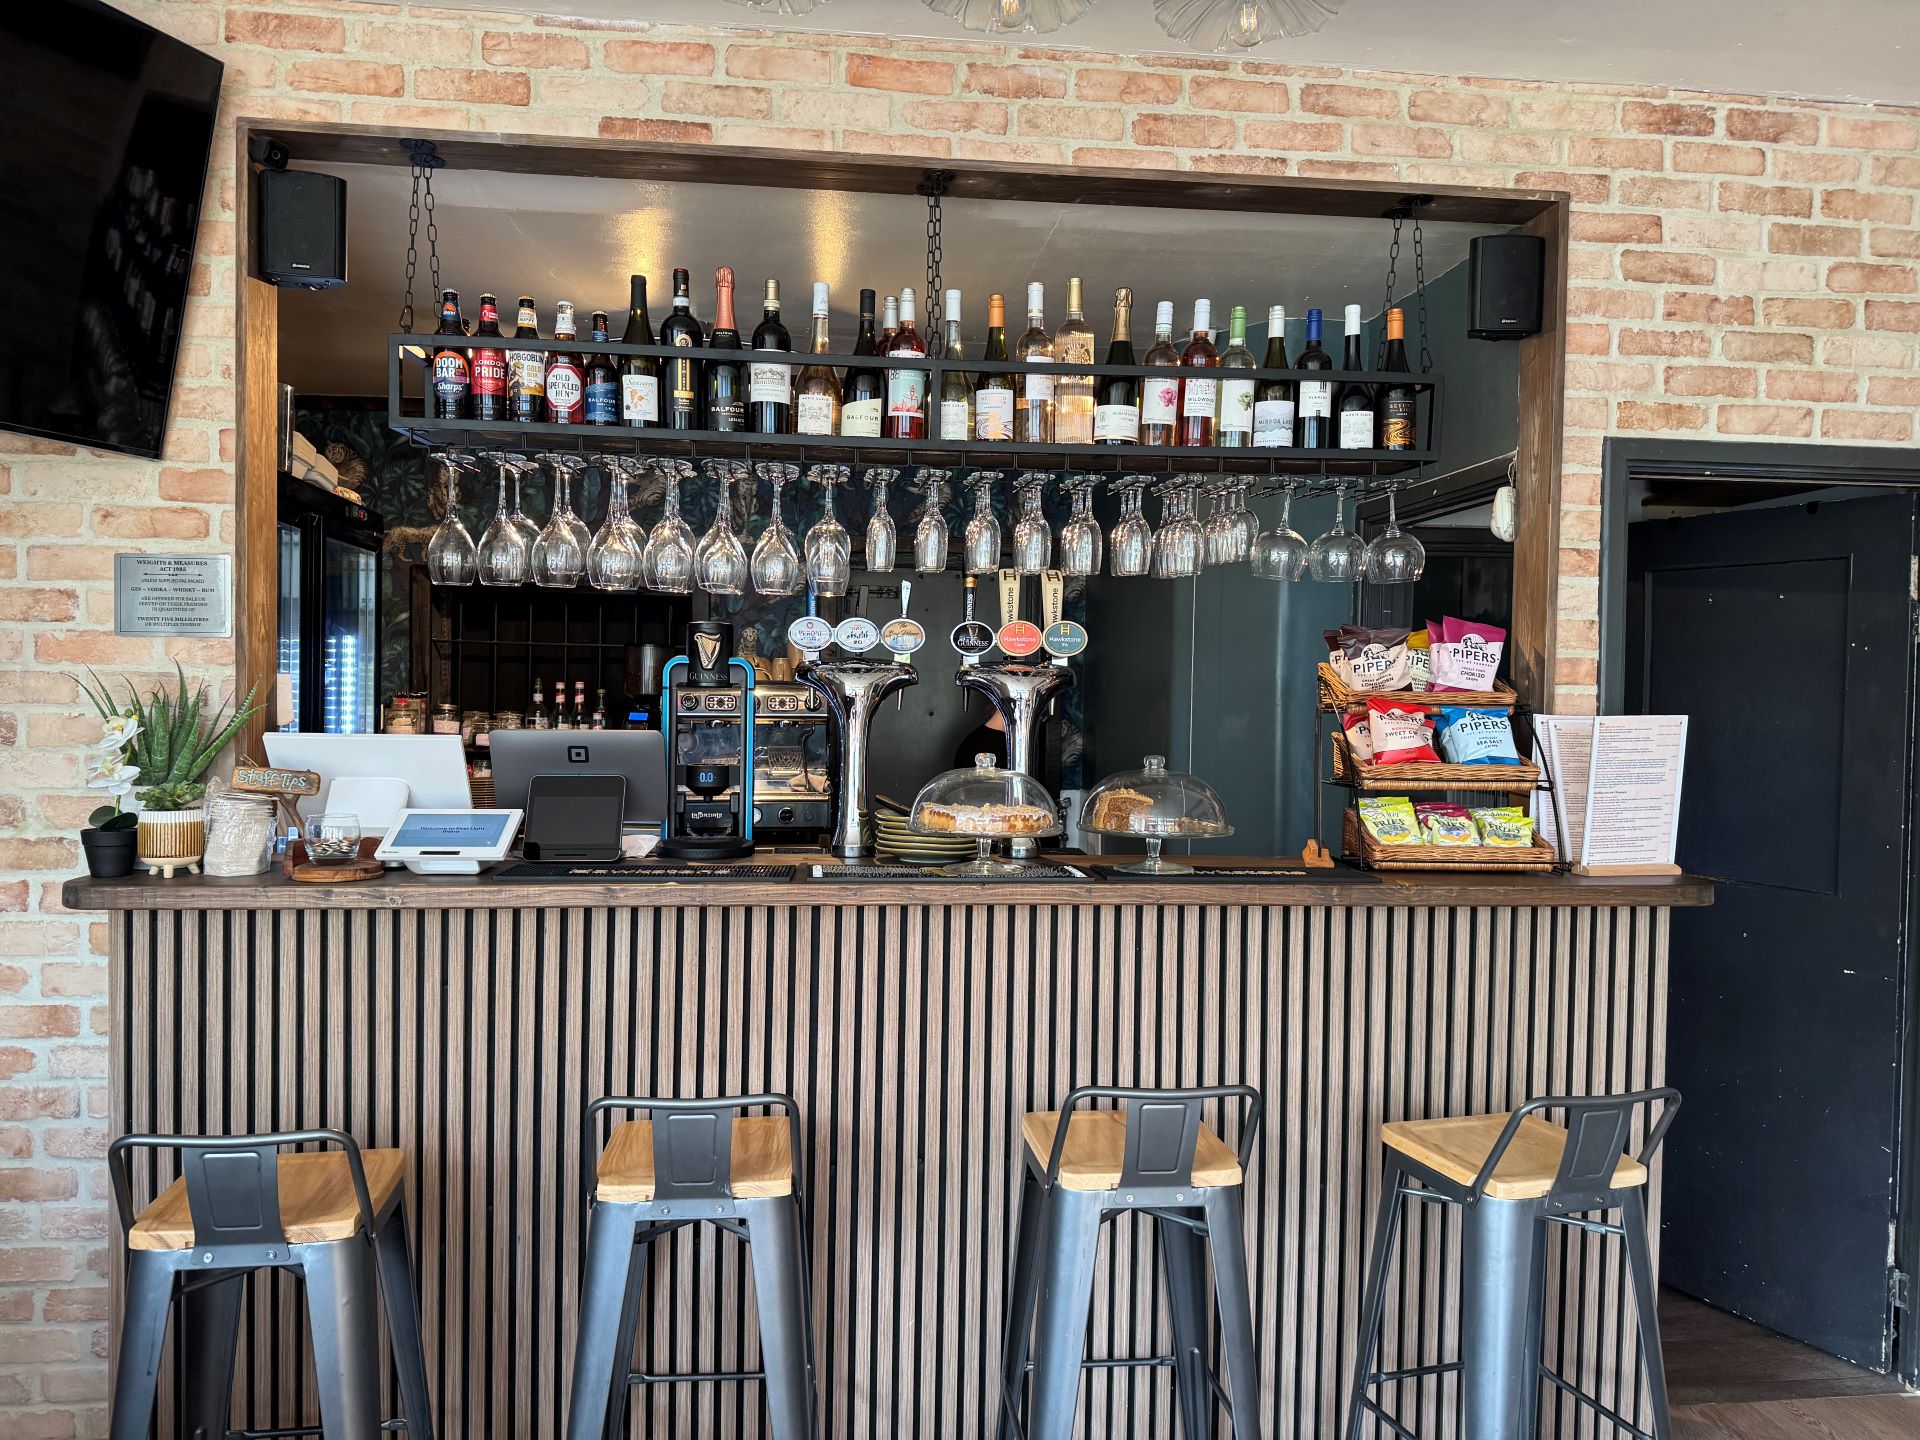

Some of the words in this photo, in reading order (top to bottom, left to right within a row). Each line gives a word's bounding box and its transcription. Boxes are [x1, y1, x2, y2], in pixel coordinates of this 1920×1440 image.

[436, 358, 463, 368] DOOM
[510, 352, 544, 364] HOBGOBLIN
[437, 368, 456, 378] BAR
[475, 367, 505, 379] PRIDE
[548, 382, 579, 391] SPECKLED
[1453, 648, 1496, 663] PIPERS
[690, 672, 728, 680] GUINNESS
[1361, 677, 1394, 687] LONGHORN
[1460, 721, 1508, 732] PIPERS
[237, 768, 280, 787] Staff
[280, 773, 307, 791] Tips
[700, 772, 713, 783] 0.0
[1373, 819, 1405, 827] FRIES
